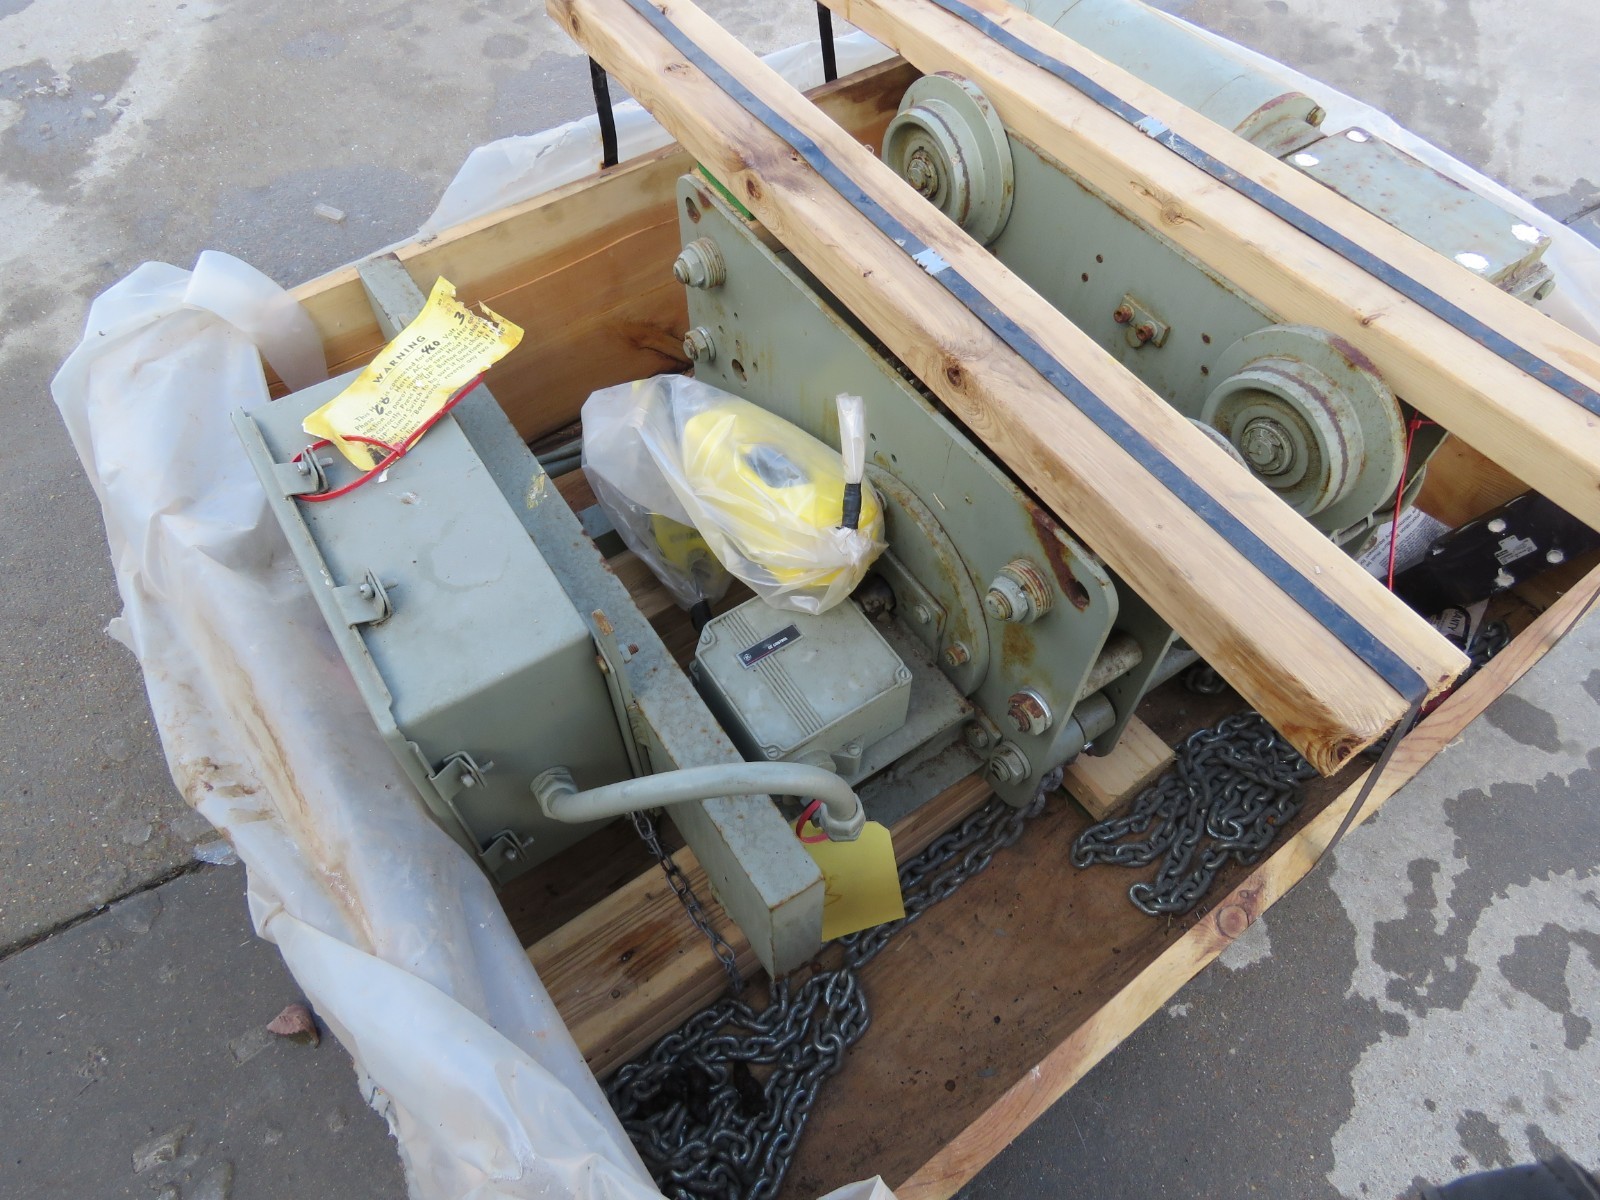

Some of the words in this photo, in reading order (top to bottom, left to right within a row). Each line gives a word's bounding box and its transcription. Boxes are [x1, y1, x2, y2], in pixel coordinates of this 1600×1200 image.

[421, 339, 440, 354] 460
[442, 327, 458, 339] Volt,
[454, 311, 464, 325] 3
[362, 417, 385, 435] nection
[392, 391, 406, 409] power
[433, 353, 446, 364] sure
[446, 341, 462, 354] Hoist
[372, 334, 426, 382] WARNING
[391, 414, 407, 428] Limit
[405, 393, 422, 412] Switch
[437, 366, 450, 377] sure
[455, 340, 484, 362] functions.
[394, 375, 413, 392] Hertz,
[425, 341, 454, 362] operation,
[453, 324, 468, 339] After
[399, 393, 413, 408] Press
[436, 353, 457, 368] Button
[457, 343, 468, 354] and
[468, 330, 483, 346] check
[399, 420, 412, 431] runs
[410, 380, 440, 416] "Backwards"
[444, 363, 465, 379] reverse
[466, 355, 477, 363] any
[478, 345, 489, 354] two
[354, 412, 369, 421] This
[389, 362, 415, 389] connected
